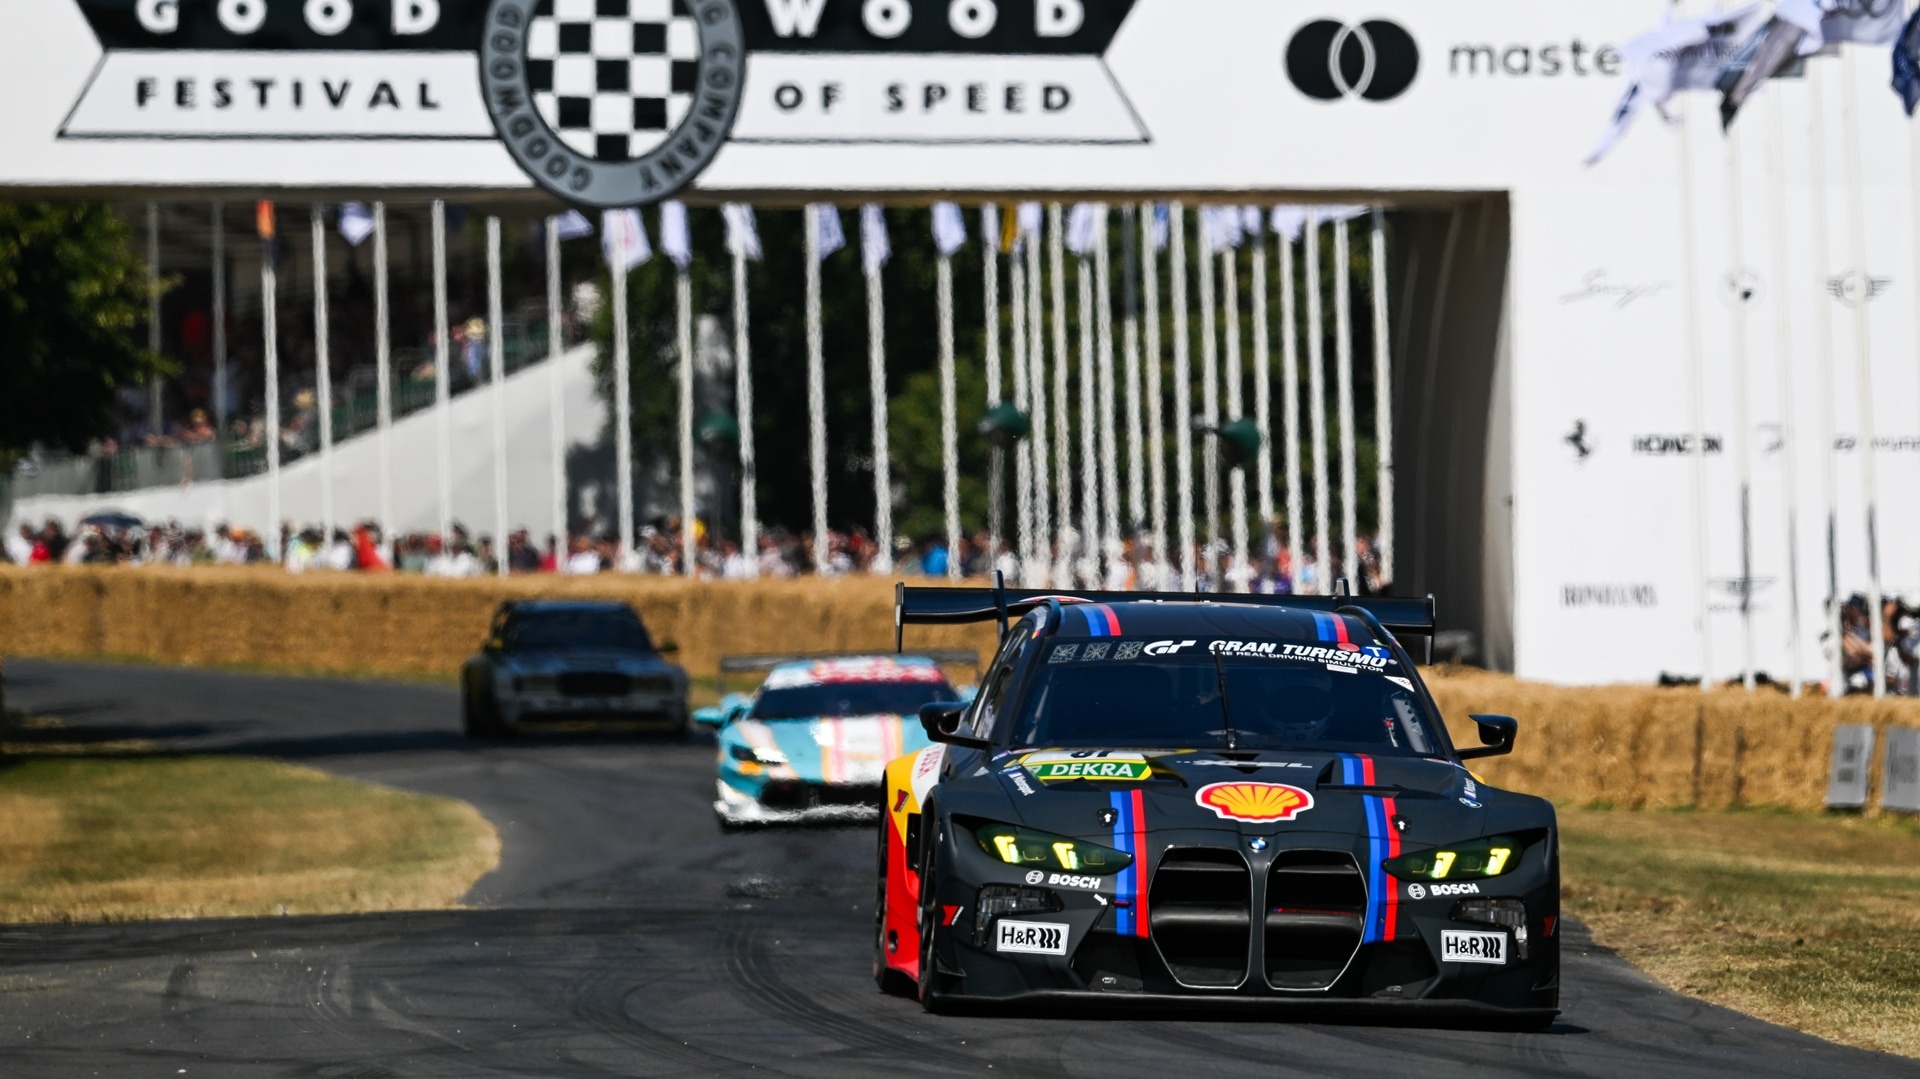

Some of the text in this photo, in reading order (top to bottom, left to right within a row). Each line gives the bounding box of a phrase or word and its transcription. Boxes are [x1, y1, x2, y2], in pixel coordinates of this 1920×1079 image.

[135, 0, 441, 36] GOOD
[769, 0, 1085, 38] WOOD
[1449, 37, 1622, 77] maste
[136, 77, 440, 109] FESTIVAL
[774, 83, 1071, 112] OF SPEED
[1208, 639, 1277, 654] GRAN
[1268, 653, 1315, 662] DRIVING
[1318, 658, 1384, 673] SIMULATOR
[1050, 763, 1134, 777] DEKRA
[1048, 873, 1101, 890] BOSCH
[1430, 883, 1480, 896] BOSCH
[1001, 926, 1036, 946] H&R
[1445, 936, 1481, 955] H&R
